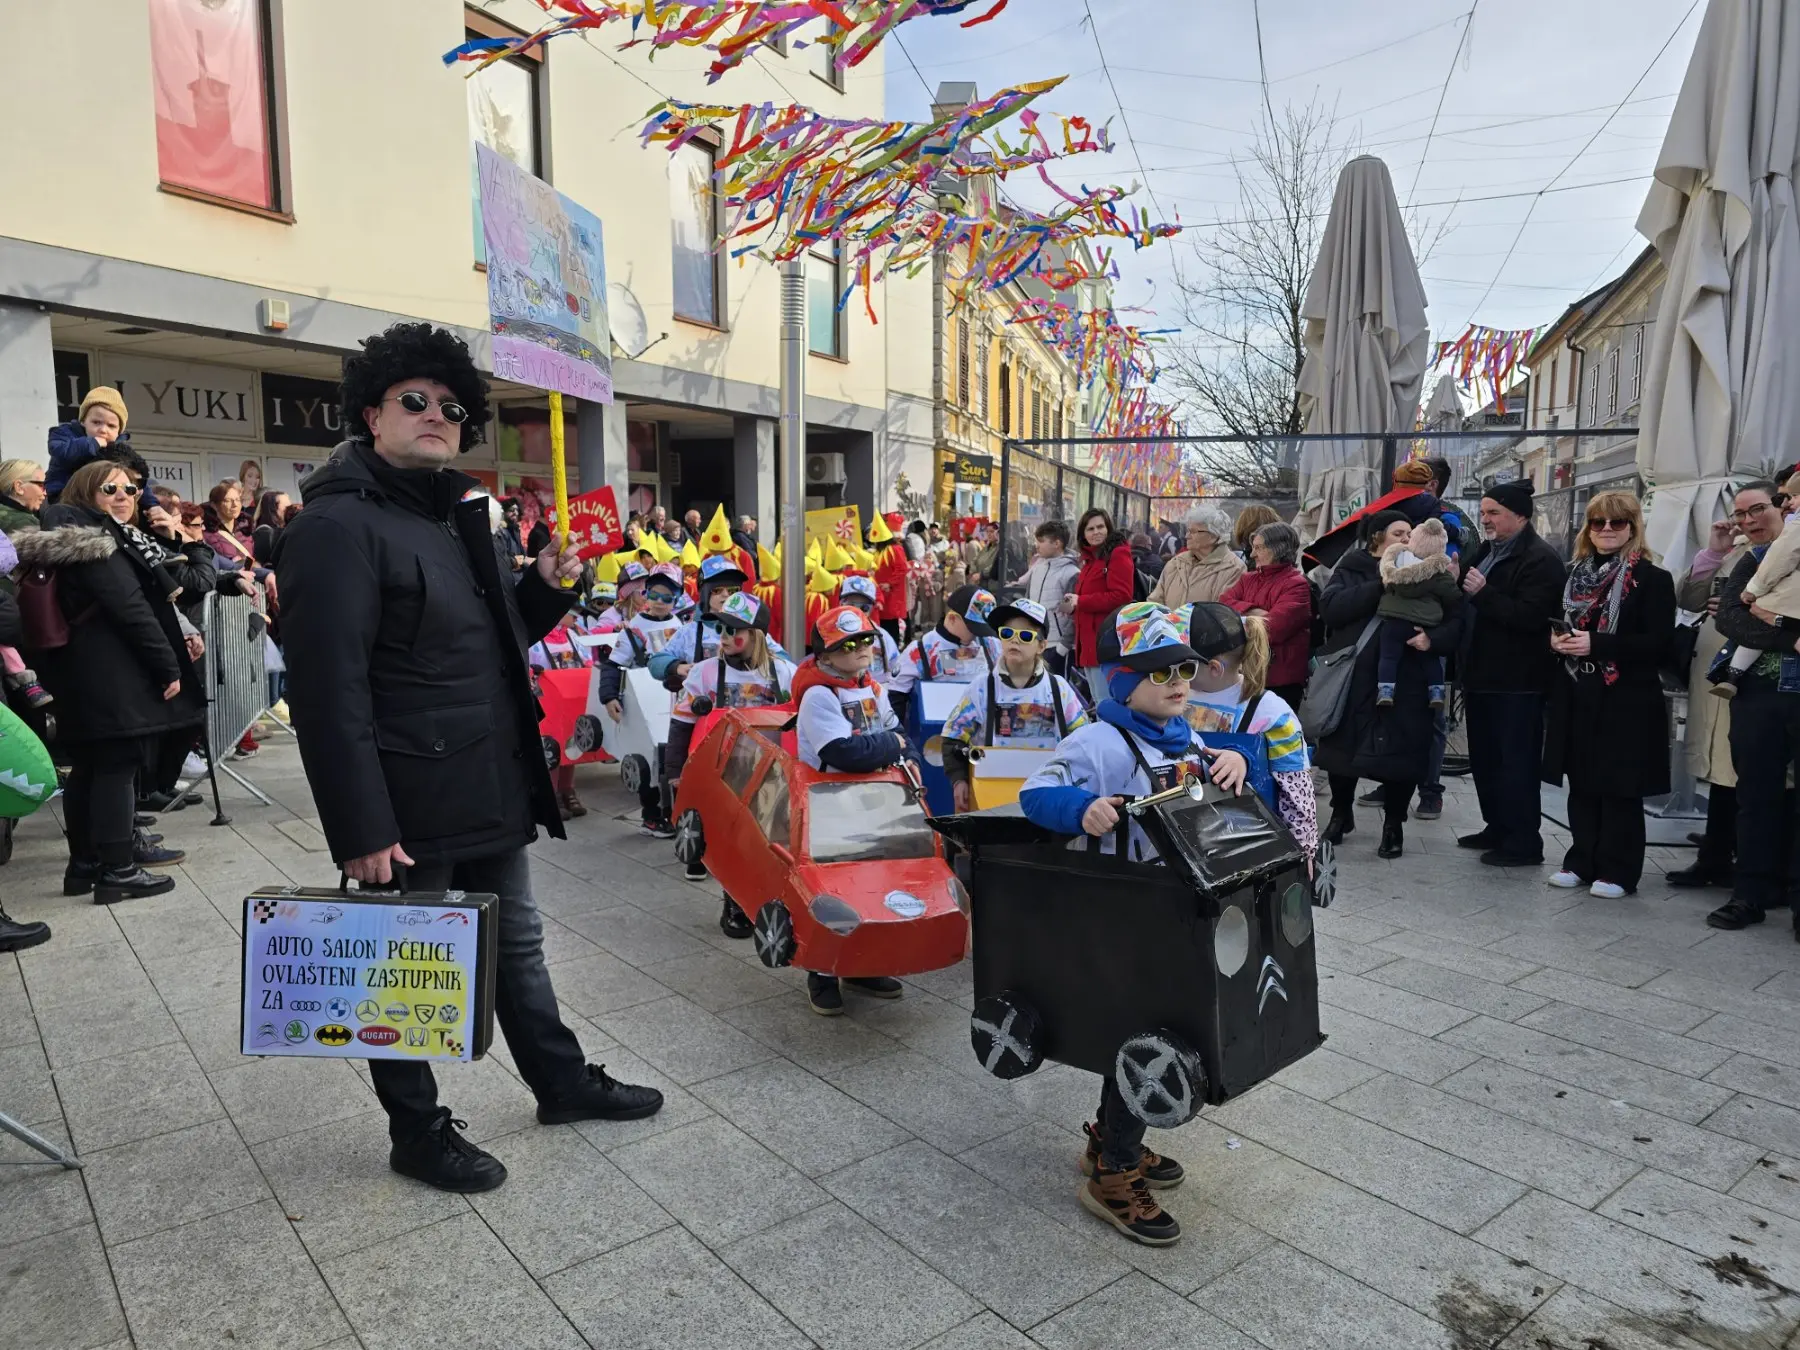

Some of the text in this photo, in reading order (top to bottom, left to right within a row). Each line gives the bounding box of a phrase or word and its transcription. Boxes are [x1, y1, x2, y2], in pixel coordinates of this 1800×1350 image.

[141, 379, 248, 422] YUKI
[272, 396, 341, 431] I YU
[149, 465, 184, 481] UKI
[960, 460, 988, 478] Sun
[265, 936, 456, 963] AUTO SALON PČELICE
[262, 962, 462, 991] OVLAŠTENI ZASTUPNIK
[261, 989, 284, 1010] ZA
[361, 1031, 396, 1040] BUGATTI
